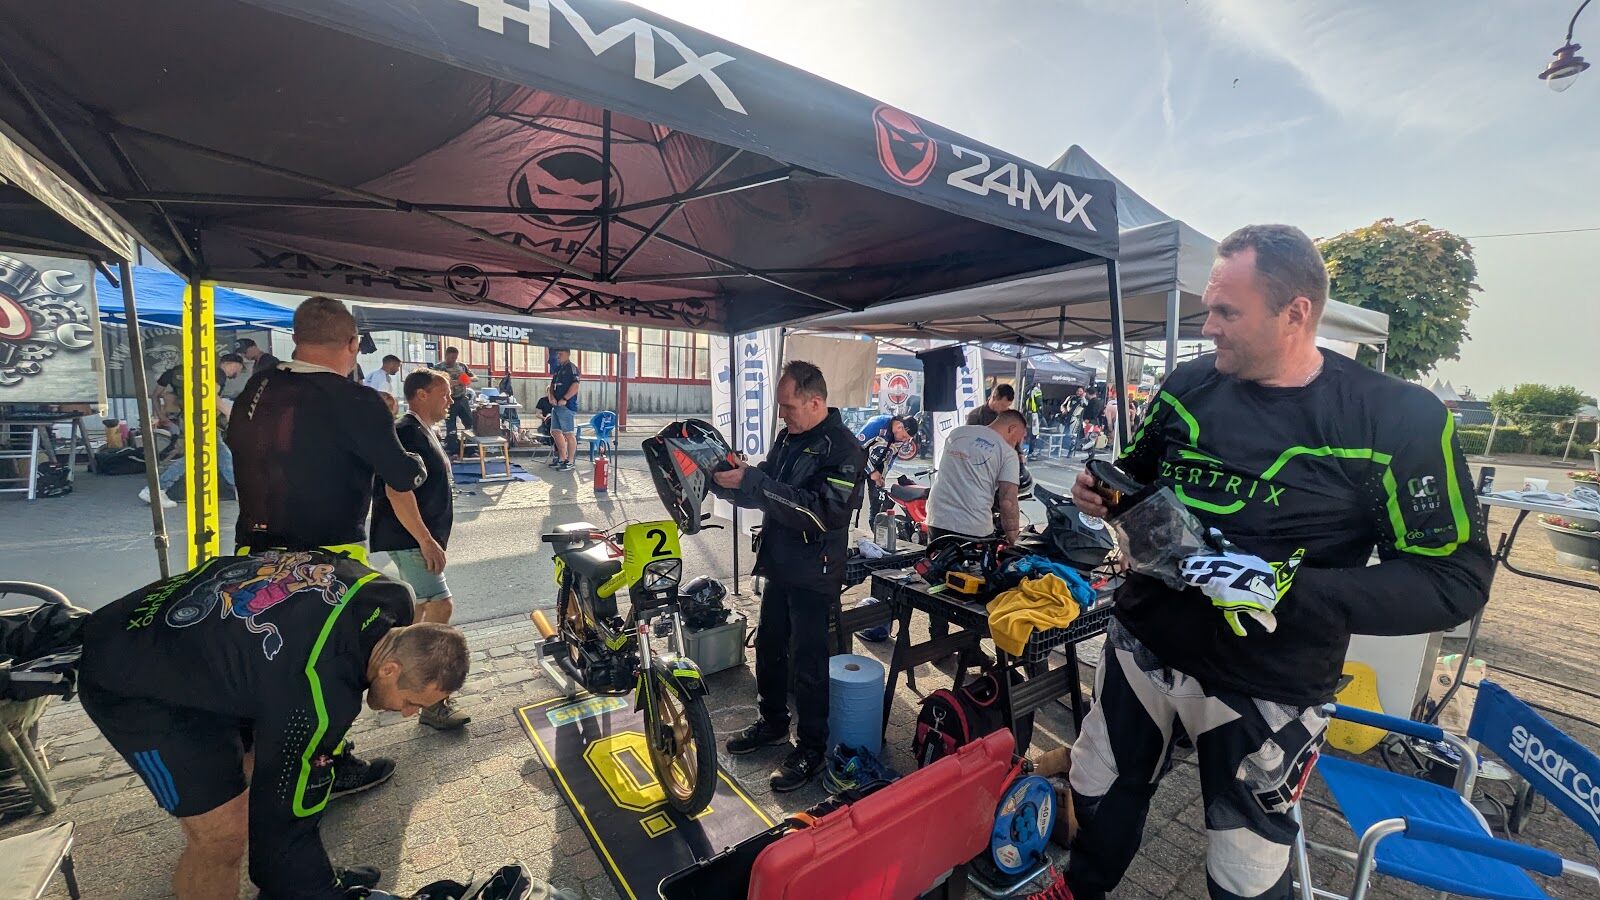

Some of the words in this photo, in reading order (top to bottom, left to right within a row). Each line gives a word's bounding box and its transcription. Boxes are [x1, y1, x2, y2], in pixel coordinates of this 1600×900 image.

[947, 144, 1097, 232] 24MX
[469, 322, 531, 339] IRONSIDE
[646, 528, 673, 558] 2
[1511, 725, 1600, 814] sparco
